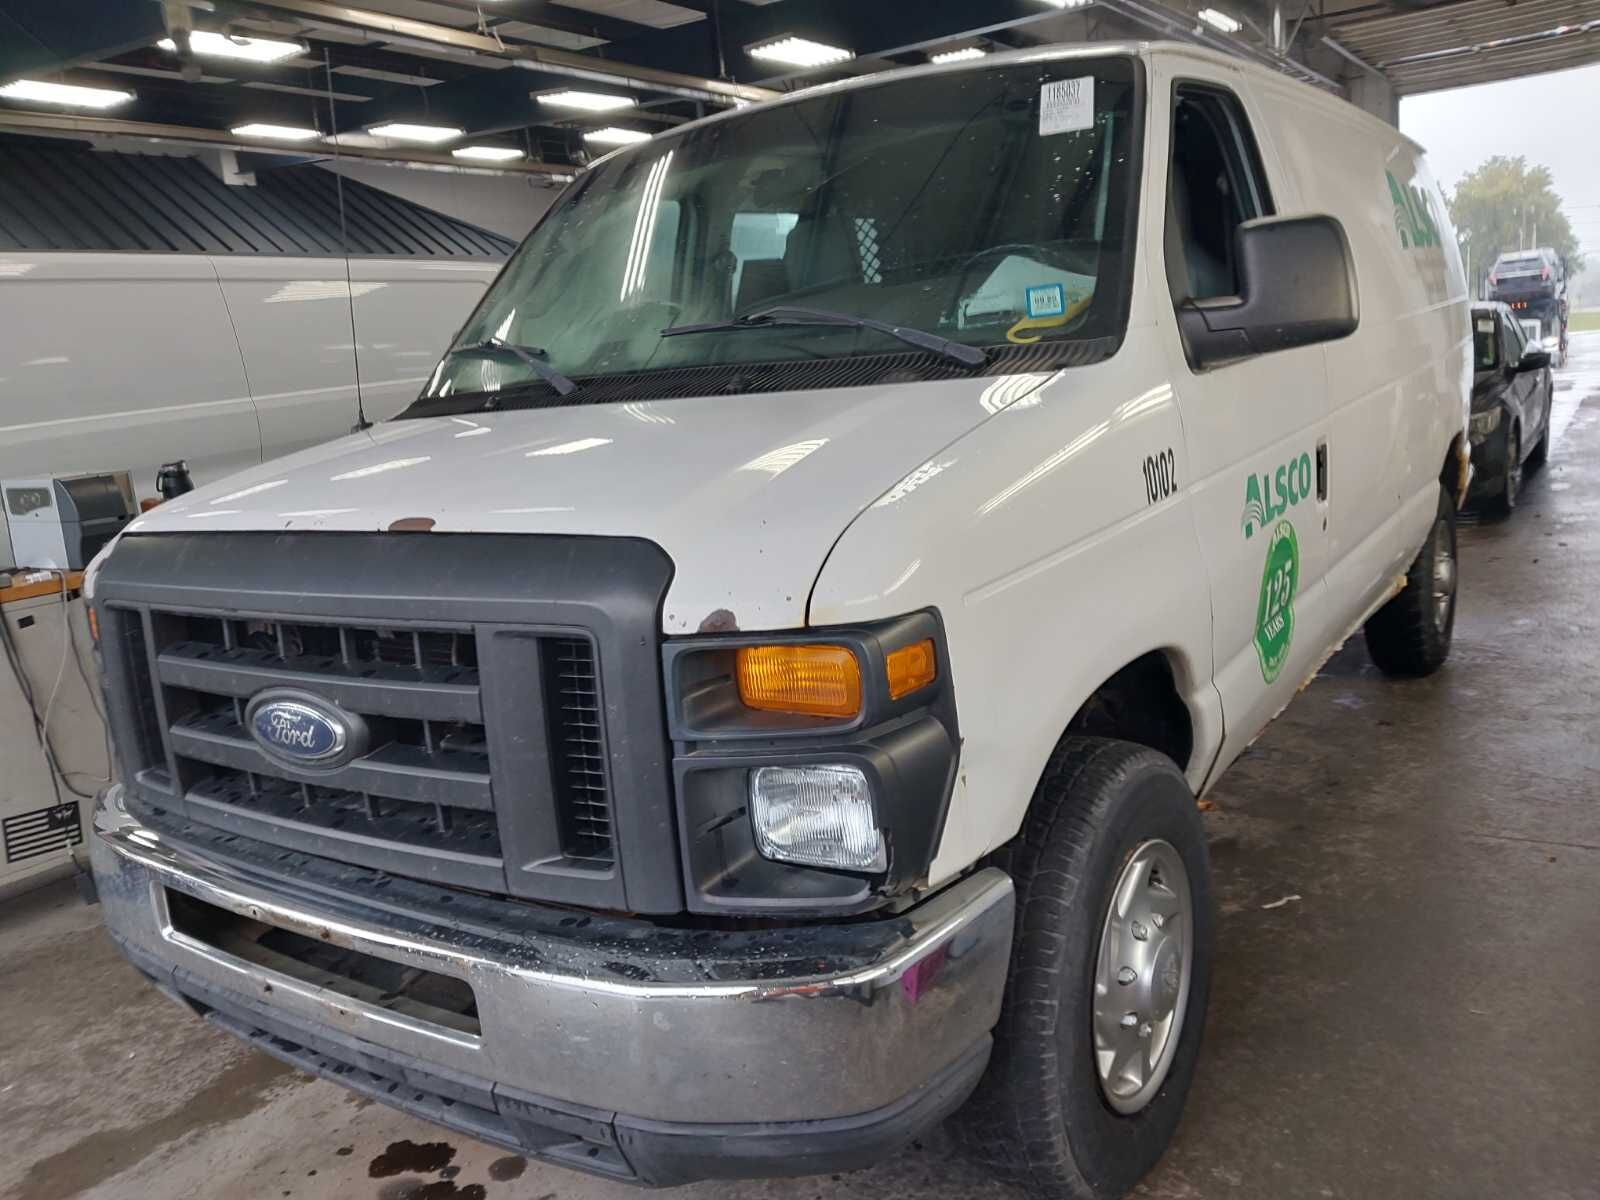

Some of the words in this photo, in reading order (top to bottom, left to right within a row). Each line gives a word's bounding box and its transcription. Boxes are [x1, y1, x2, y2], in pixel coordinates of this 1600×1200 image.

[1142, 447, 1178, 504] 10102
[1243, 452, 1312, 539] ALSCO
[1263, 560, 1293, 625] 125
[1264, 614, 1285, 641] YEARS
[270, 710, 316, 748] Ford
